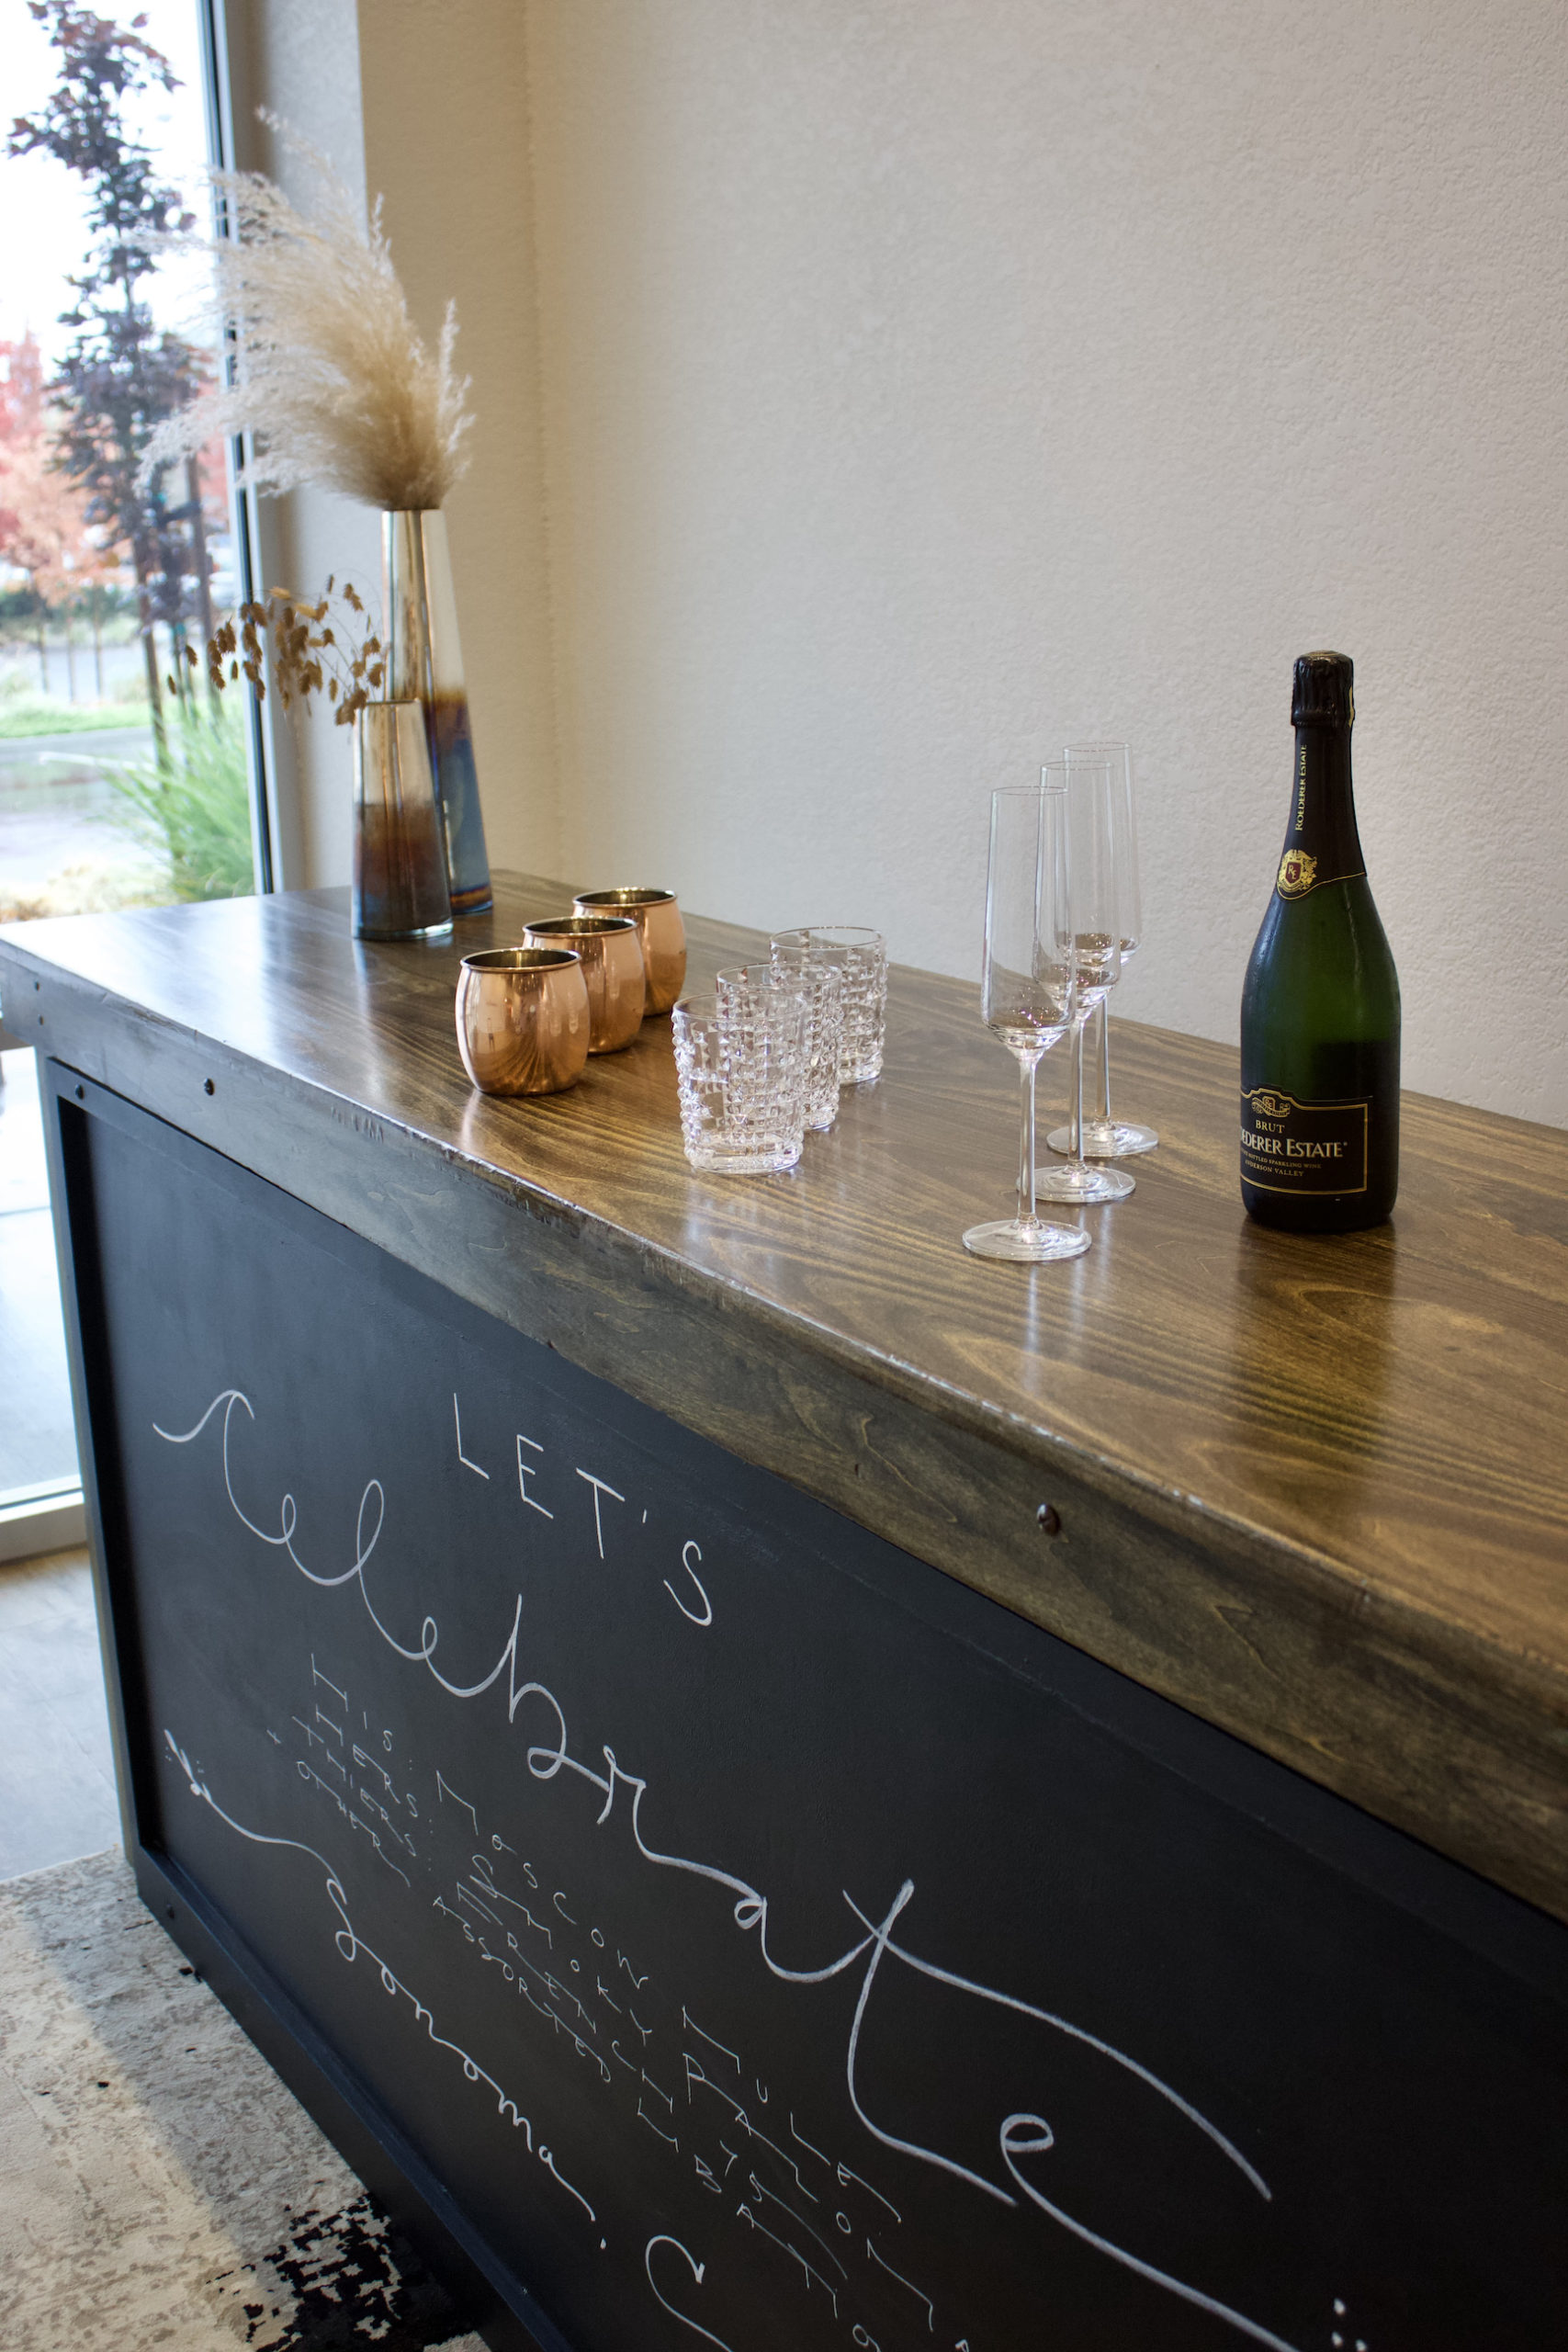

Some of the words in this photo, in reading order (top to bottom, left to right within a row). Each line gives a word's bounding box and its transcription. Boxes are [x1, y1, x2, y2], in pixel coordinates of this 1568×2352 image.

[1299, 744, 1307, 776] ESTATE
[1294, 778, 1306, 831] ROEDERER
[1241, 1128, 1284, 1156] EDERER
[1286, 1138, 1344, 1158] ESTATE
[1255, 1119, 1286, 1134] BRUT
[1274, 1167, 1305, 1177] VALLEY
[453, 1392, 713, 1626] LET'S
[436, 1770, 649, 1989] MOSCOW
[682, 2005, 902, 2224] MULE
[637, 2097, 881, 2352] LIBATIO
